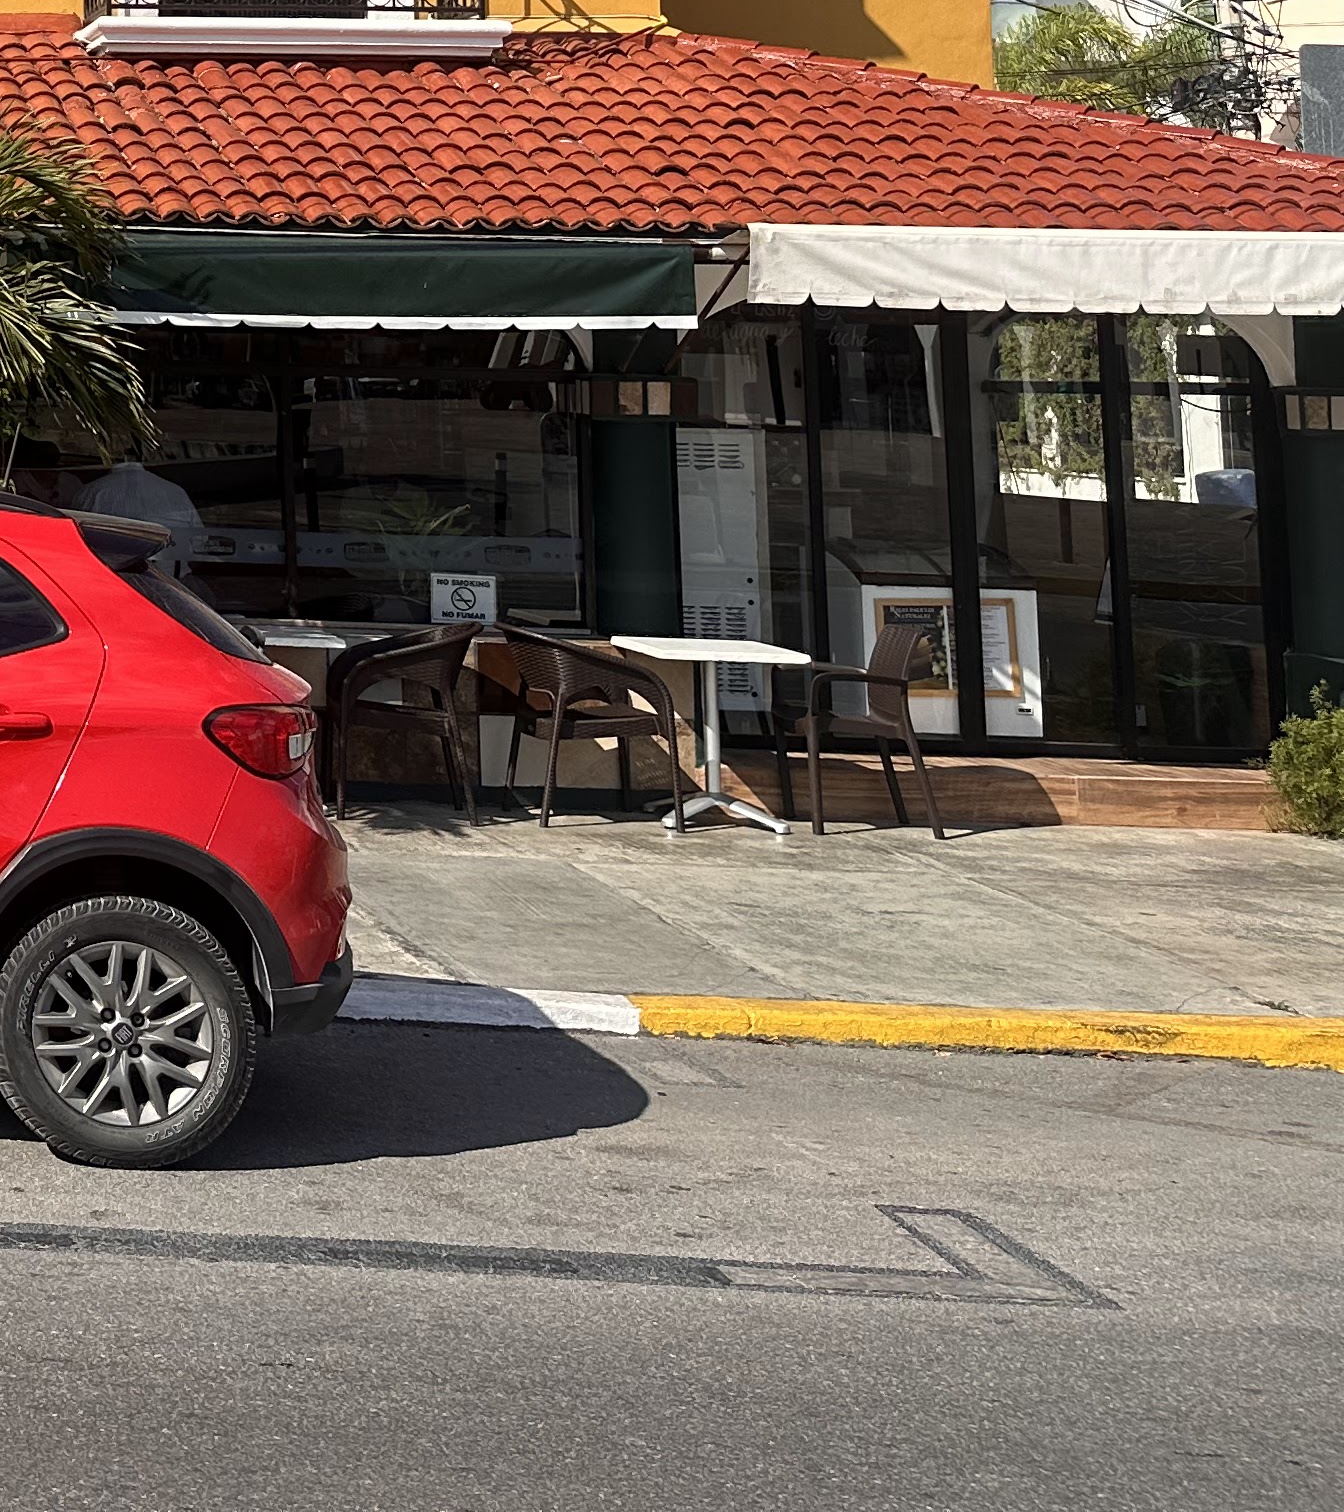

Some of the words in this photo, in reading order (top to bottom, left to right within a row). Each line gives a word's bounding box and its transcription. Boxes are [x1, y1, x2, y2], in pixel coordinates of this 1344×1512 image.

[436, 578, 449, 586] NO
[451, 579, 491, 588] SMOKING
[442, 610, 455, 618] NO
[456, 611, 486, 620] FUMAR
[16, 951, 56, 1035] PIRELLI
[192, 1007, 231, 1123] SCORPION
[145, 1119, 187, 1144] ATR
